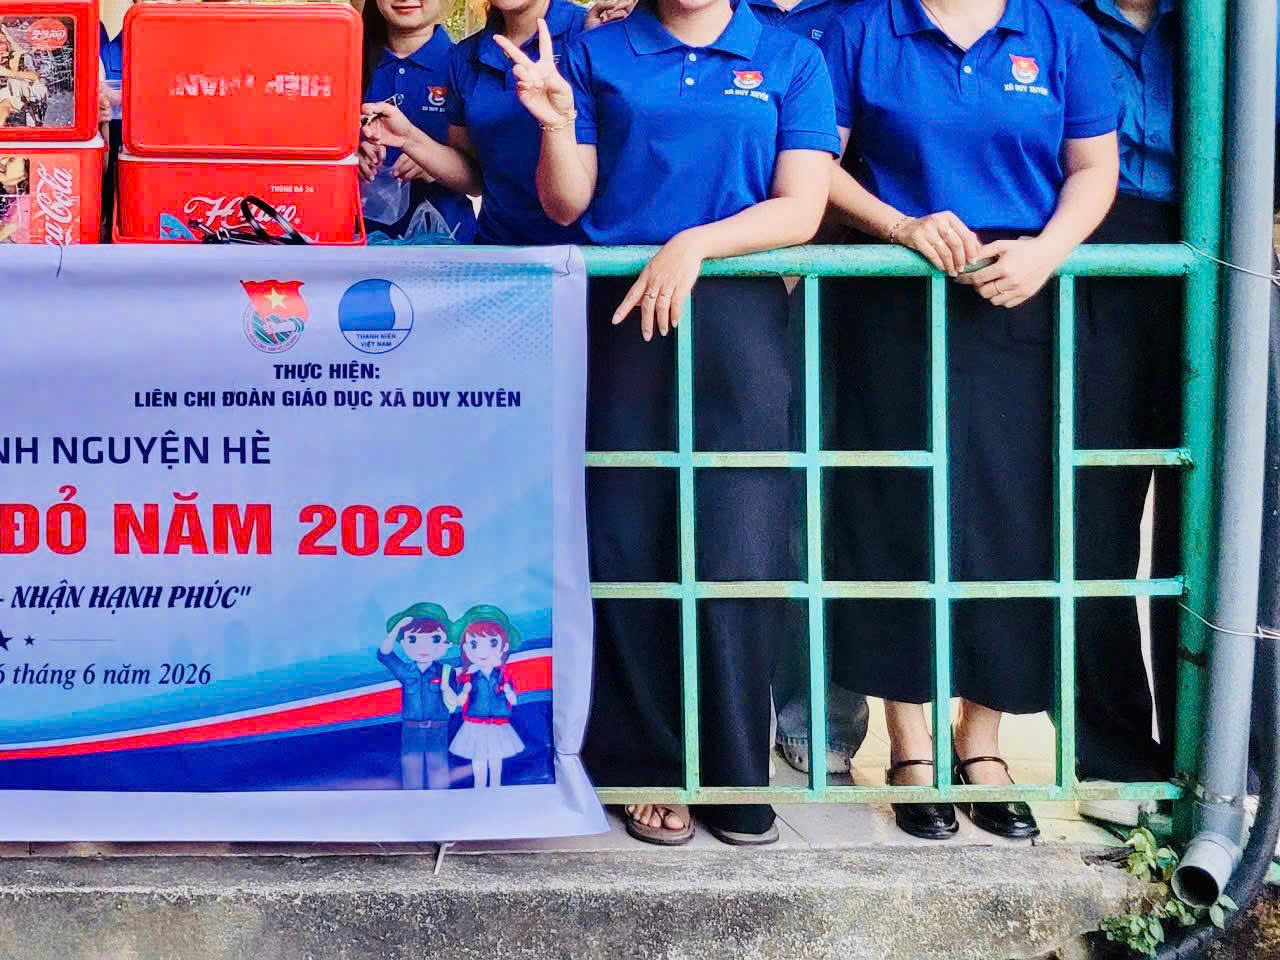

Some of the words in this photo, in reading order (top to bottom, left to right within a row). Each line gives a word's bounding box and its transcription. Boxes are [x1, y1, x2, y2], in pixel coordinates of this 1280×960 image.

[36, 161, 73, 247] ca-Cola
[273, 362, 322, 382] THỰC
[329, 360, 379, 382] HIỆN:
[135, 389, 177, 407] LIÊN
[184, 392, 215, 407] CHI
[222, 388, 275, 406] ĐOÀN
[282, 388, 327, 406] GIÁO
[334, 391, 372, 410] DỤC
[380, 388, 406, 407] XÃ
[413, 392, 450, 407] DUY
[457, 388, 520, 407] XUYÊN
[53, 430, 208, 469] NGUYỆN
[224, 429, 270, 464] HÈ
[114, 492, 272, 555] NĂM
[298, 504, 464, 556] 2026
[11, 579, 85, 614] NHẬN
[88, 586, 163, 614] HẠNH
[168, 580, 251, 608] PHÚC"
[13, 663, 76, 690] tháng
[83, 664, 95, 684] 6
[104, 664, 150, 685] năm
[158, 663, 211, 684] 2026
